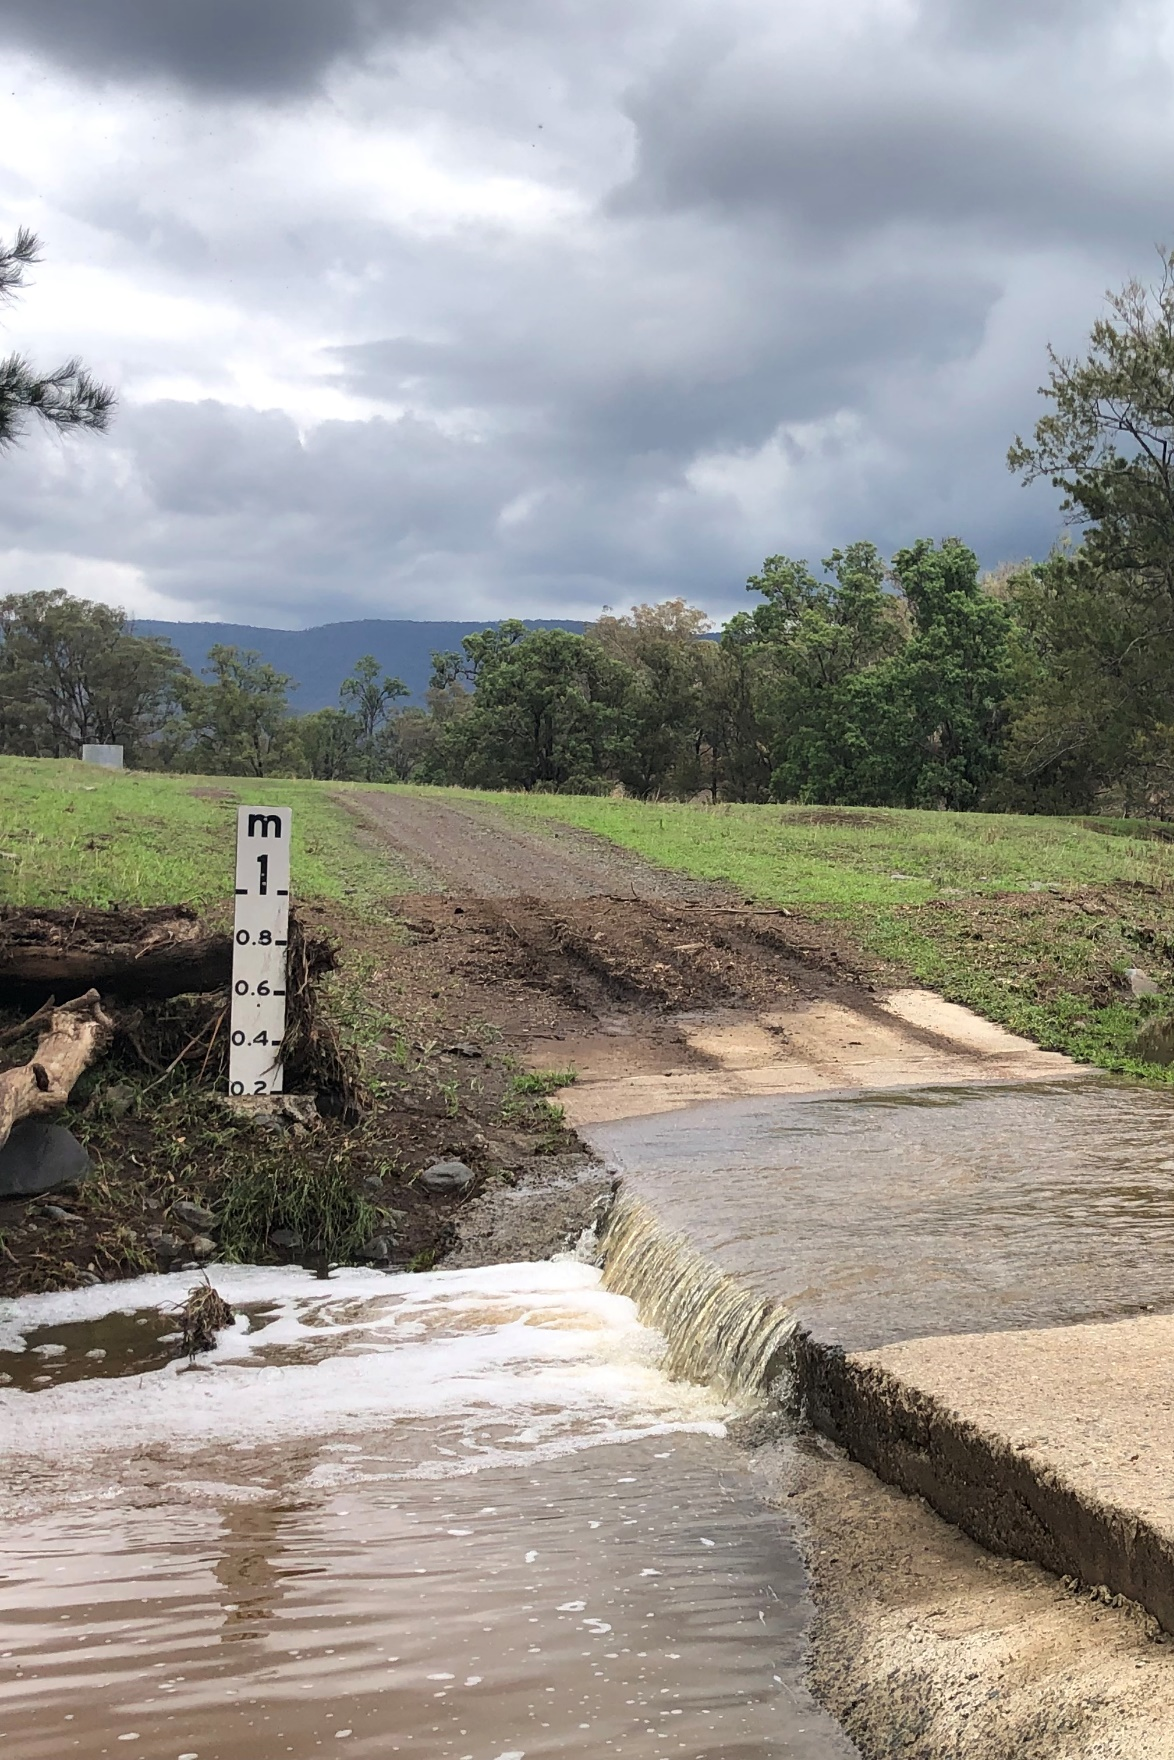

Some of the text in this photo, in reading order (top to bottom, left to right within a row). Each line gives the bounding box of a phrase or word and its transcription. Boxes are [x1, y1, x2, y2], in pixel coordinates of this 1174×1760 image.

[248, 813, 282, 838] m
[257, 854, 269, 896] 1
[236, 930, 272, 946] 0.8
[235, 980, 271, 996] 0.6
[232, 1031, 269, 1046] 0.4
[231, 1080, 267, 1096] 0.2
